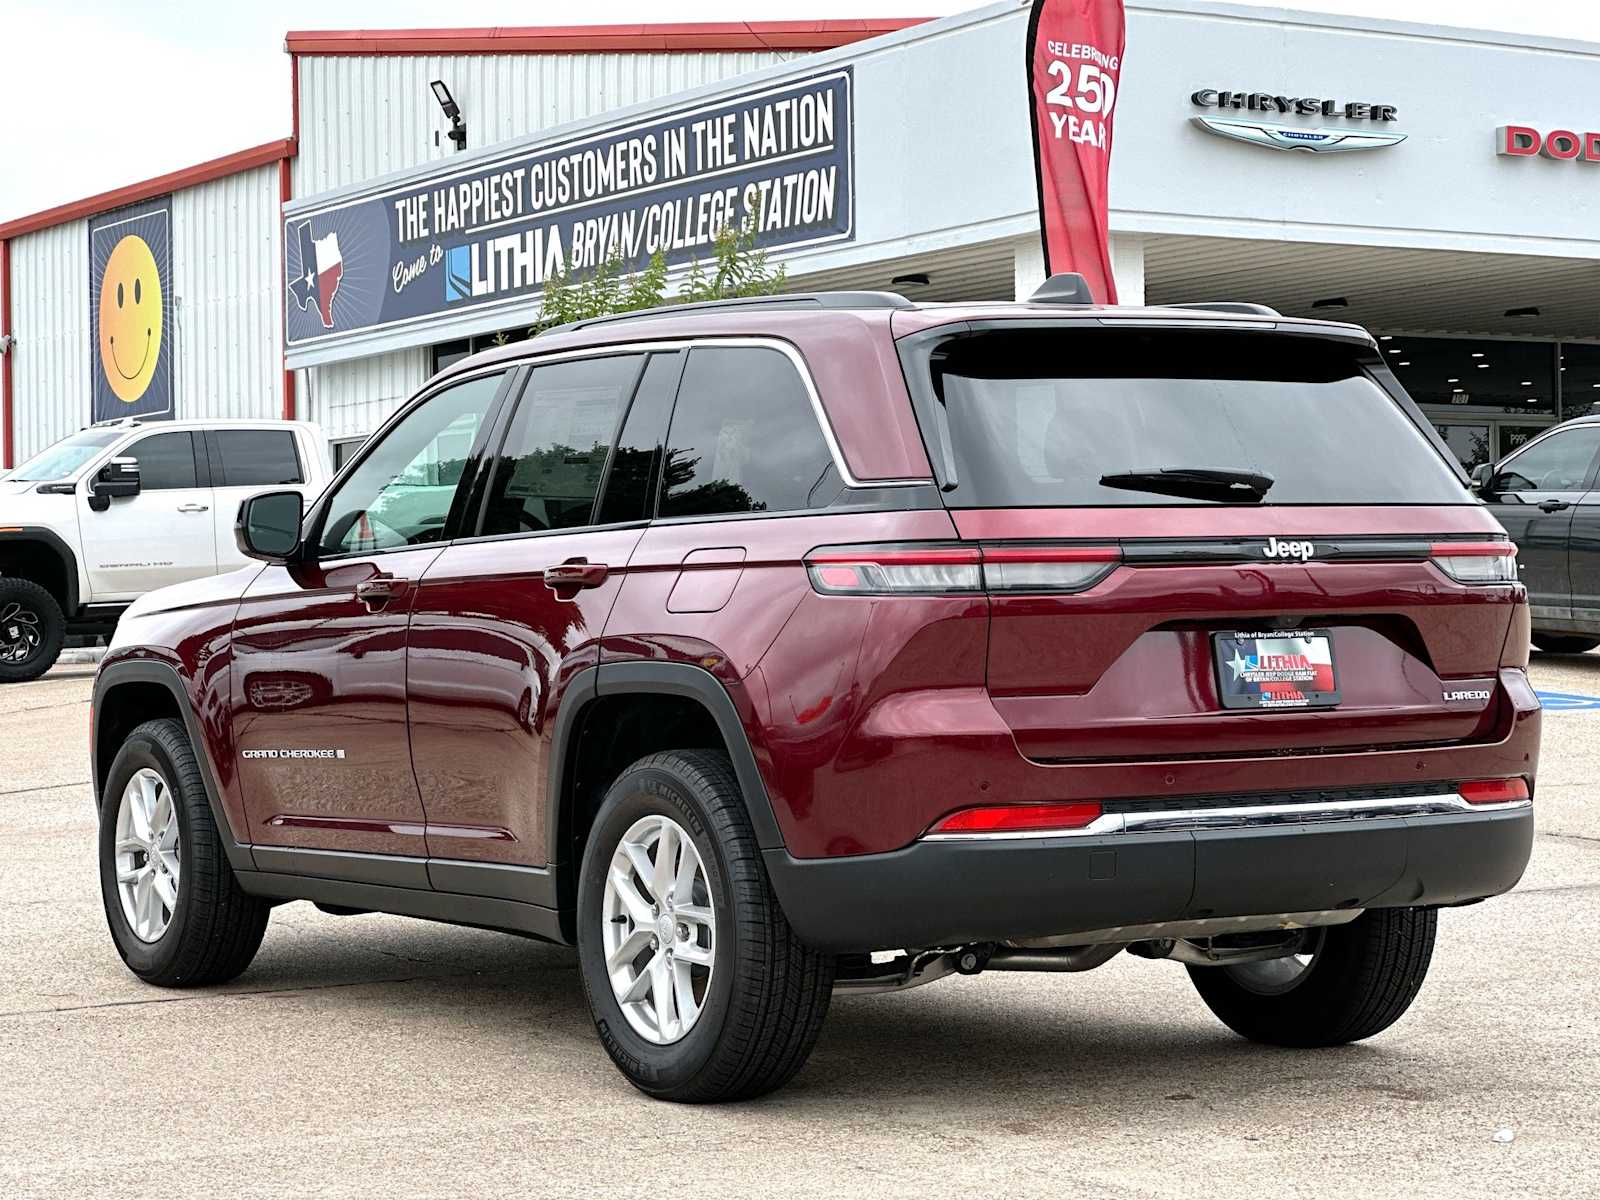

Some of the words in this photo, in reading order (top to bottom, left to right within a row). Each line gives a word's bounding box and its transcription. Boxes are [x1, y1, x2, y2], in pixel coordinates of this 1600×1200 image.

[1046, 60, 1115, 120] 250
[1191, 88, 1398, 121] CHRYSLER
[395, 193, 429, 242] THE
[434, 168, 525, 234] HAPPIEST
[531, 134, 657, 210] CUSTOMERS
[663, 126, 686, 179] IN
[692, 113, 736, 171] THE
[743, 89, 834, 161] NATION
[392, 255, 427, 293] Come
[429, 244, 443, 266] to
[471, 224, 565, 297] LITHIA
[571, 187, 738, 270] BRYAN/COLLEGE
[741, 166, 837, 234] STATION
[1263, 537, 1314, 561] Jeep
[1260, 654, 1313, 670] LITHIA
[1443, 691, 1490, 701] LAREDO
[242, 750, 279, 759] GRAND
[280, 749, 336, 759] CHEROKEE
